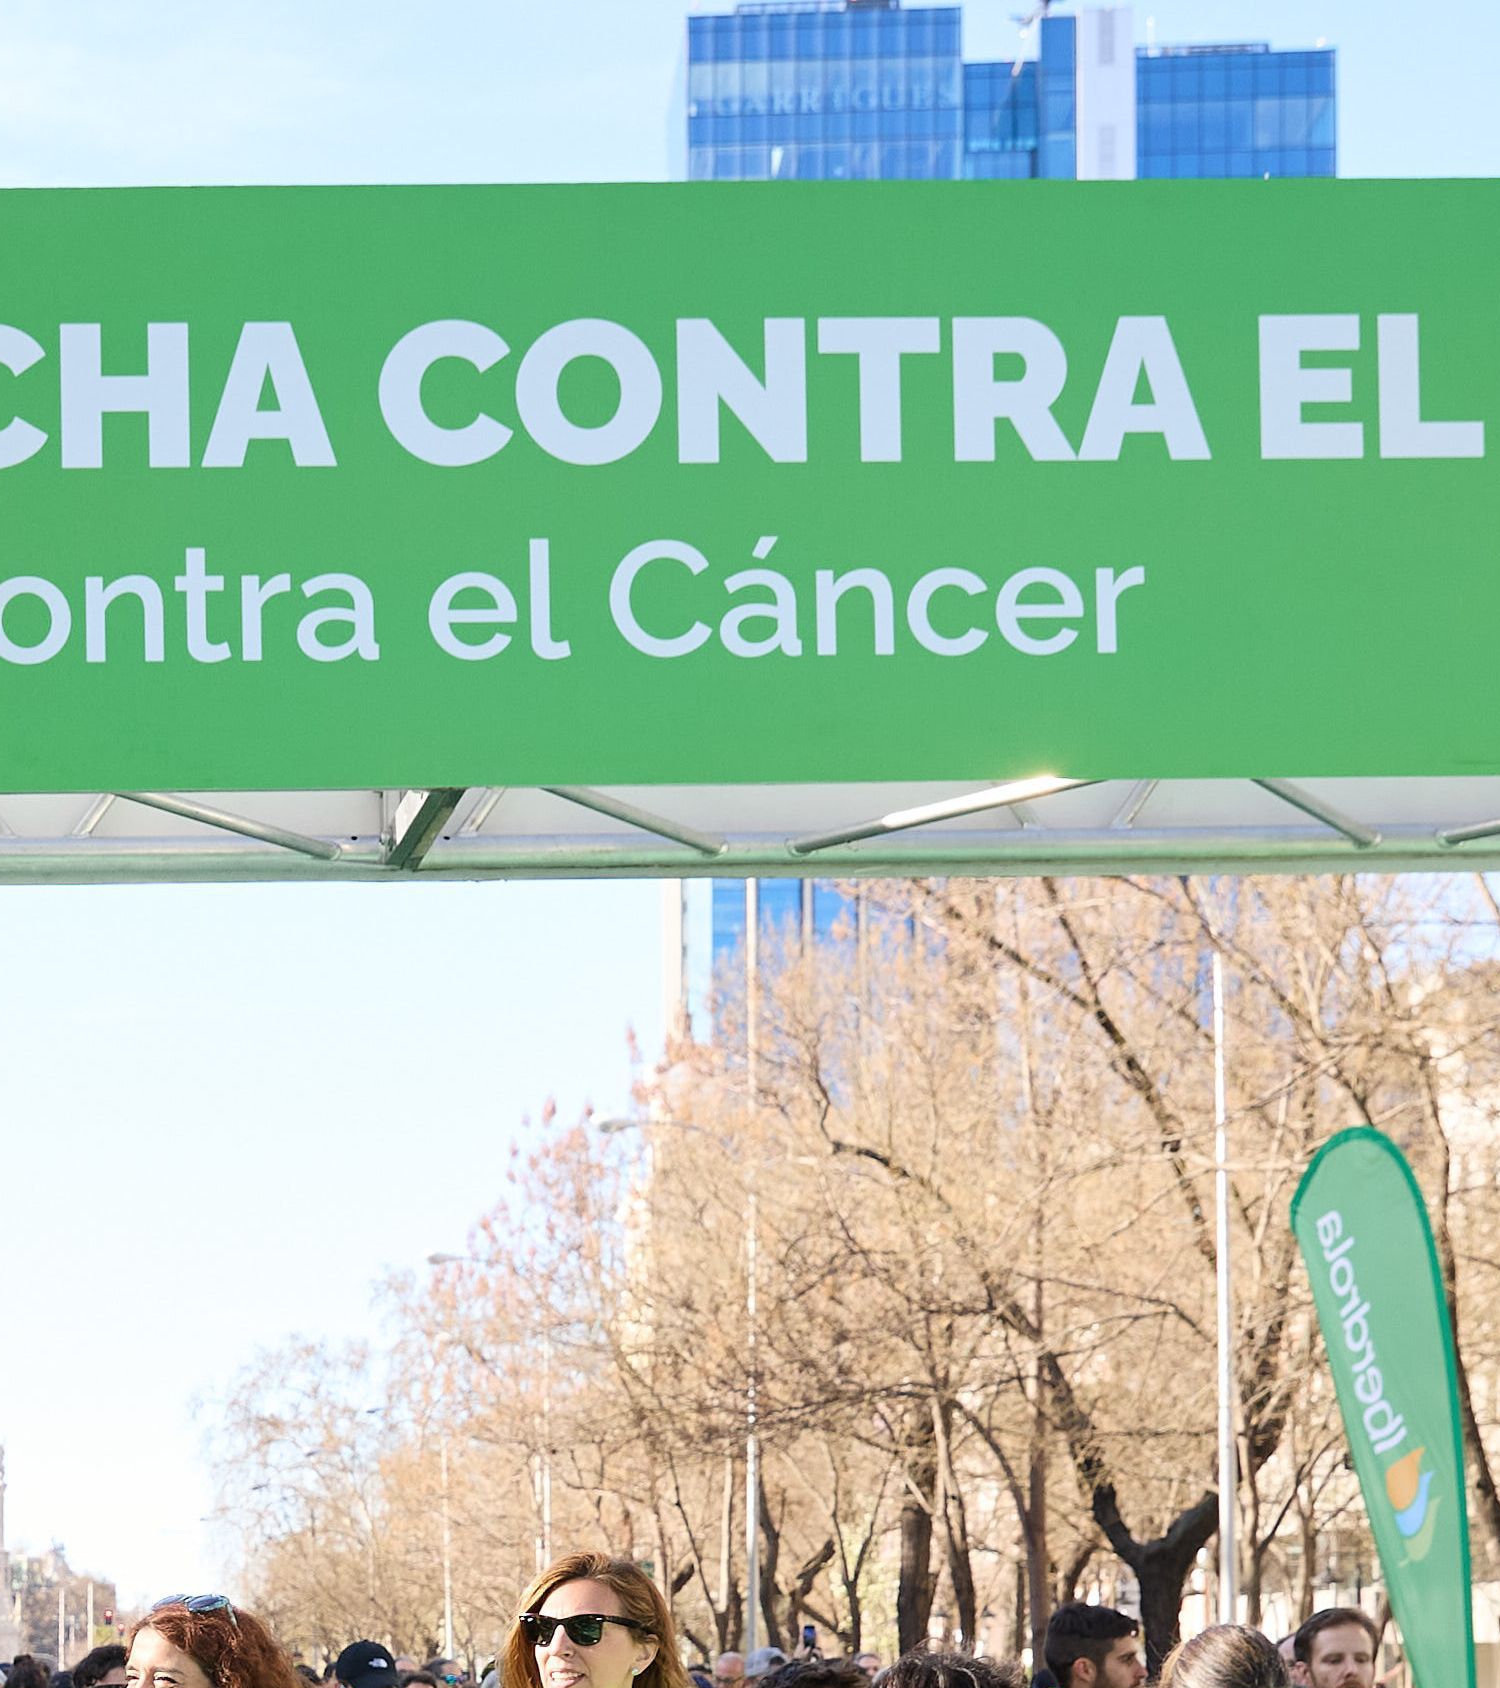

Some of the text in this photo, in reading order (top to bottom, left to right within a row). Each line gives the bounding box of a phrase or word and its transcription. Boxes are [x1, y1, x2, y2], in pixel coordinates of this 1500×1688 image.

[378, 314, 1211, 468] CONTRA
[1258, 312, 1485, 460] EL
[427, 536, 571, 662] el
[609, 532, 1145, 660] Cáncer
